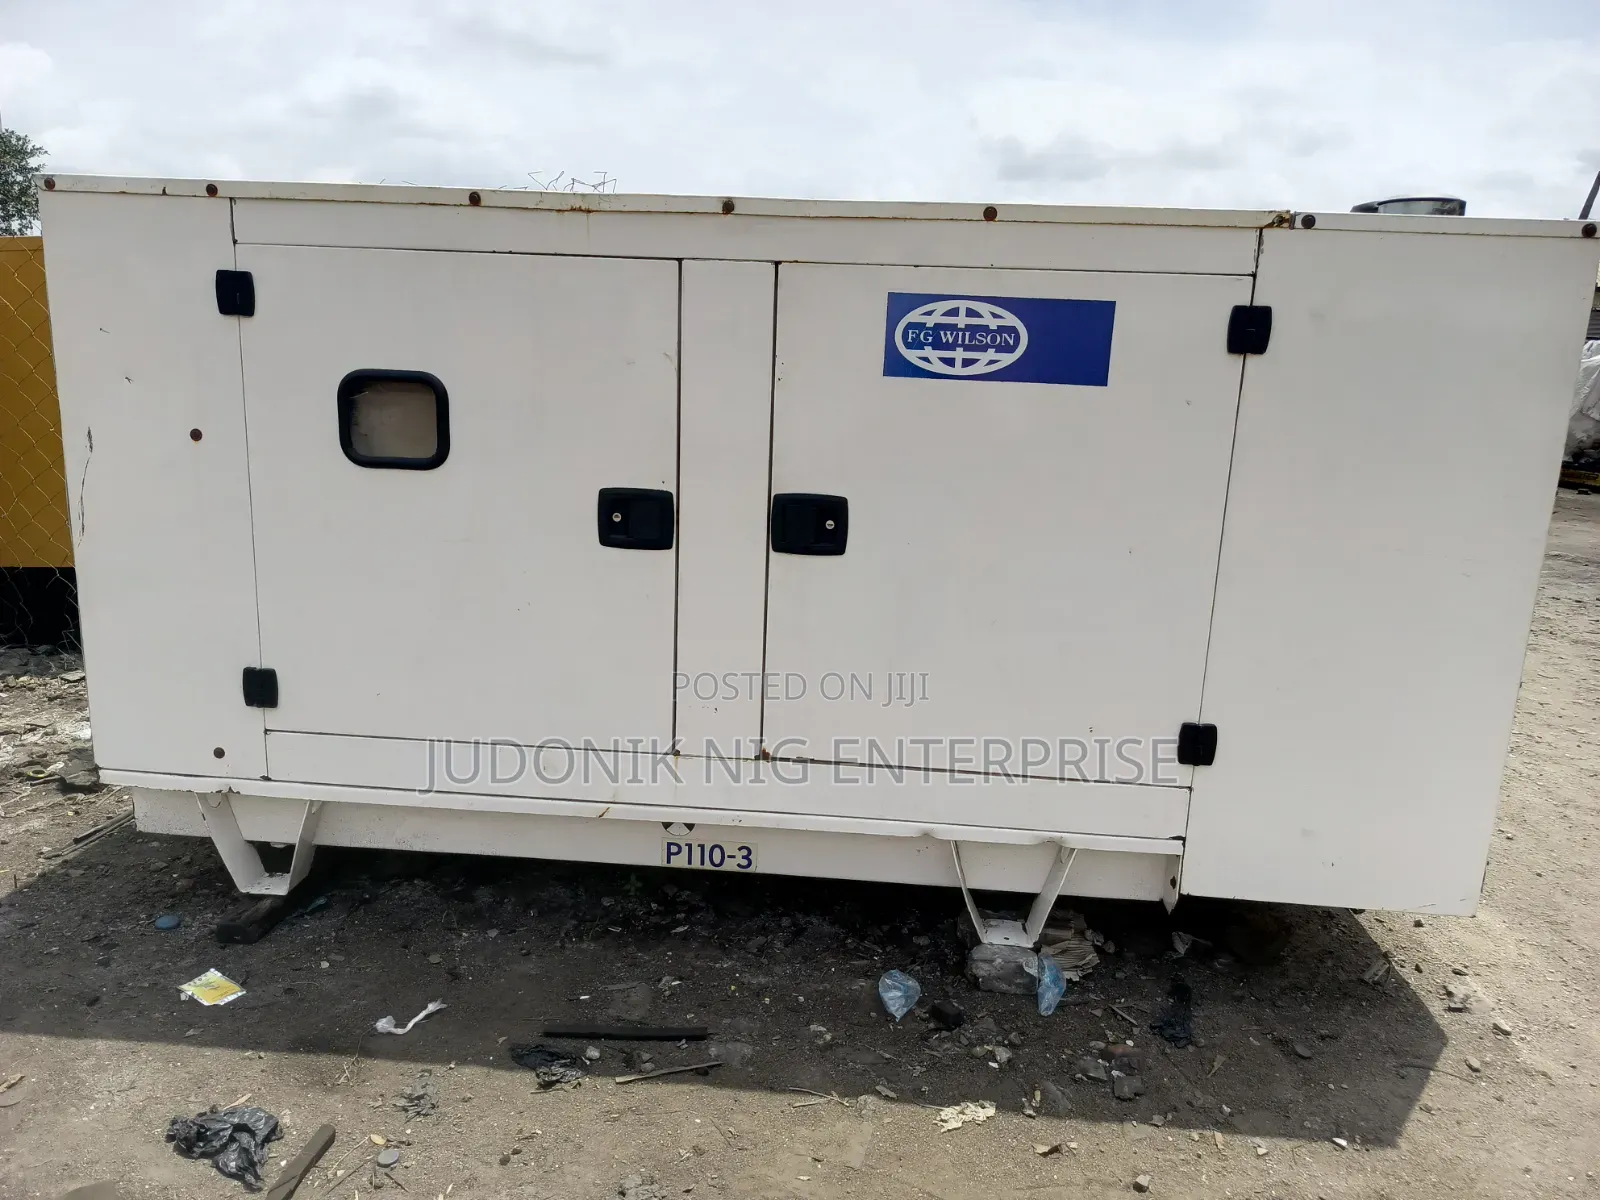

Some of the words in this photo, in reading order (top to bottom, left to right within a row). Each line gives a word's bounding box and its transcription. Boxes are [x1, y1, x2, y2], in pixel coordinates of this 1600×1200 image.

[907, 329, 933, 343] FG
[940, 331, 1015, 346] WILSON
[666, 841, 753, 870] P110-3
